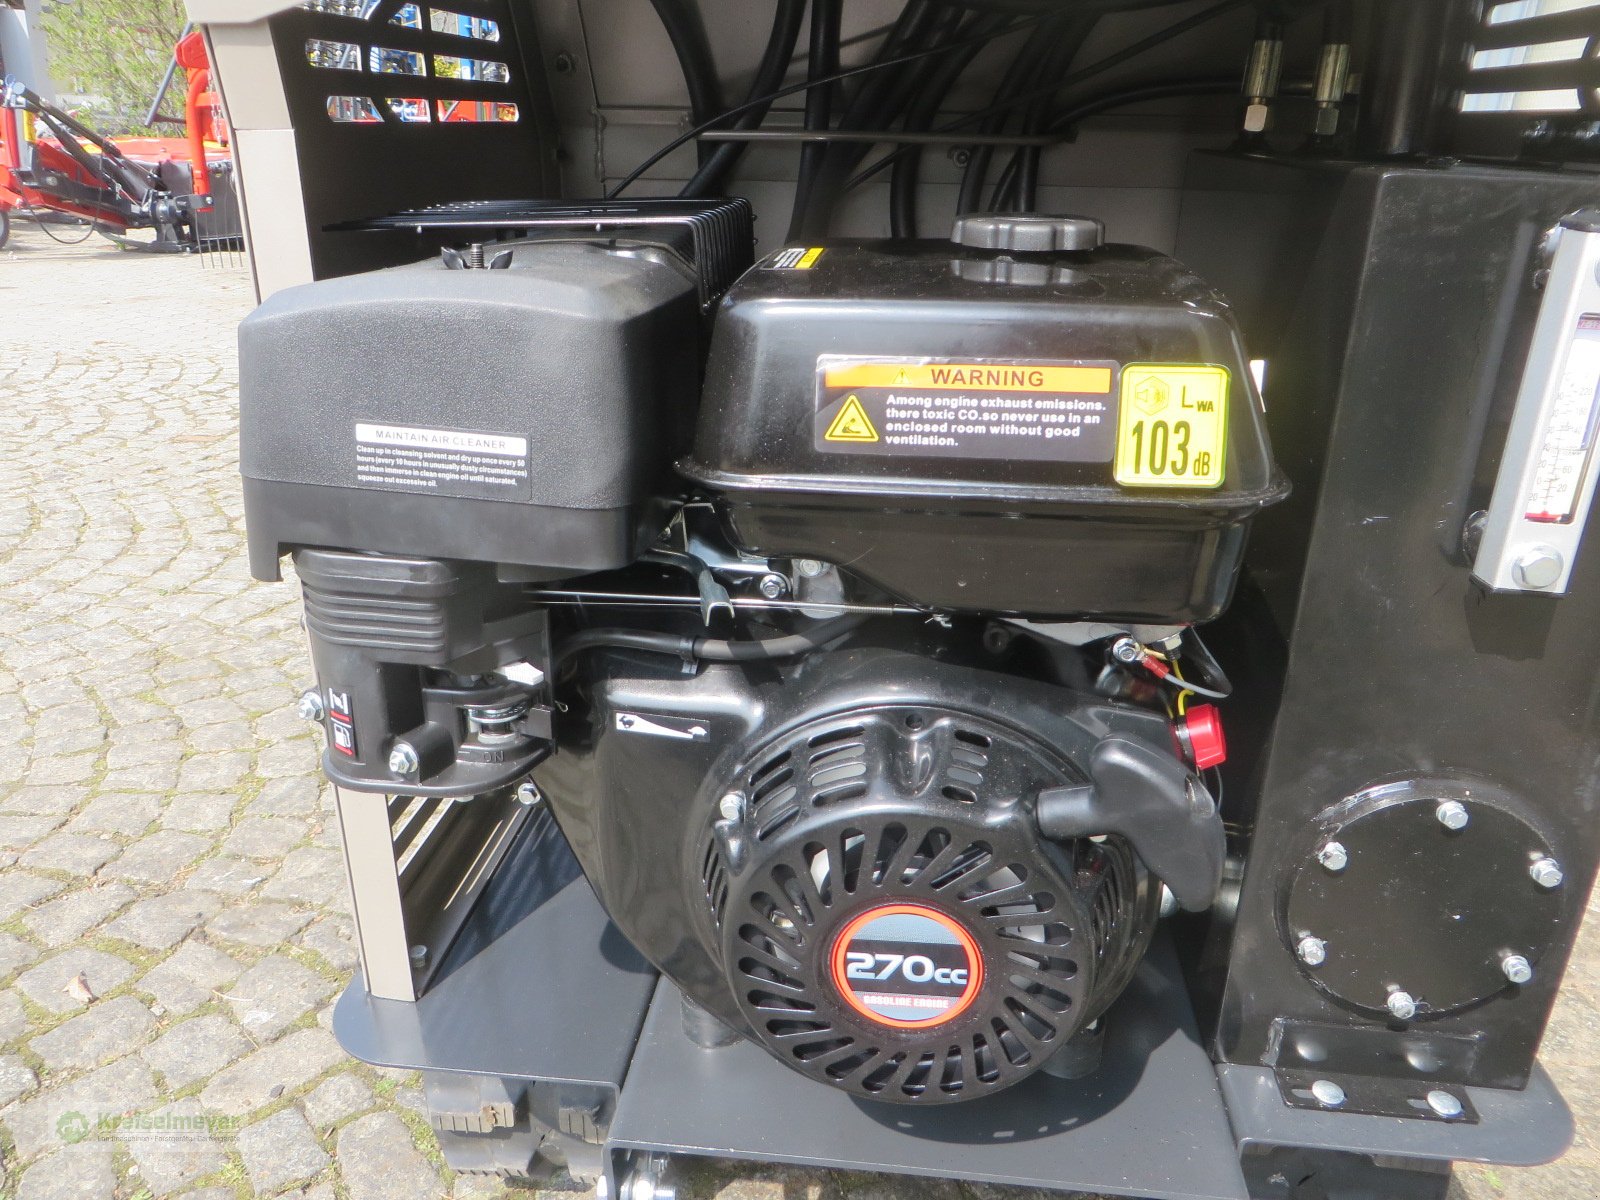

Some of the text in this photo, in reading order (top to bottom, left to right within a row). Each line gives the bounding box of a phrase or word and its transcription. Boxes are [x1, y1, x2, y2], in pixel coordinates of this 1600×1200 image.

[931, 368, 1044, 387] WARNING
[886, 394, 1106, 410] Among engine exhaust emissions.
[886, 408, 920, 419] there
[922, 409, 955, 419] toxic
[1001, 413, 1039, 422] never
[1041, 413, 1066, 422] use
[1068, 413, 1081, 423] in
[1083, 414, 1100, 423] an
[885, 421, 1081, 438] enclosed room without good
[375, 430, 506, 449] MAINTAIN AIR CLEANER
[885, 435, 959, 446] ventilation.
[1132, 420, 1210, 476] 103 dB
[356, 445, 375, 454] Clean
[375, 447, 385, 456] up
[392, 448, 423, 459] cleansing
[423, 452, 447, 460] solvent
[460, 455, 472, 463] dry
[498, 459, 516, 467] every
[356, 454, 375, 462] hours
[403, 458, 422, 467] hours
[460, 464, 478, 473] dusty
[357, 464, 370, 472] and
[370, 465, 384, 473] then
[384, 466, 412, 475] immerse
[412, 468, 420, 476] in
[420, 469, 438, 477] clean
[438, 472, 460, 480] engine
[469, 474, 484, 482] until
[846, 951, 968, 985] 270cc
[863, 995, 949, 1008] GASOLINE ENGINE
